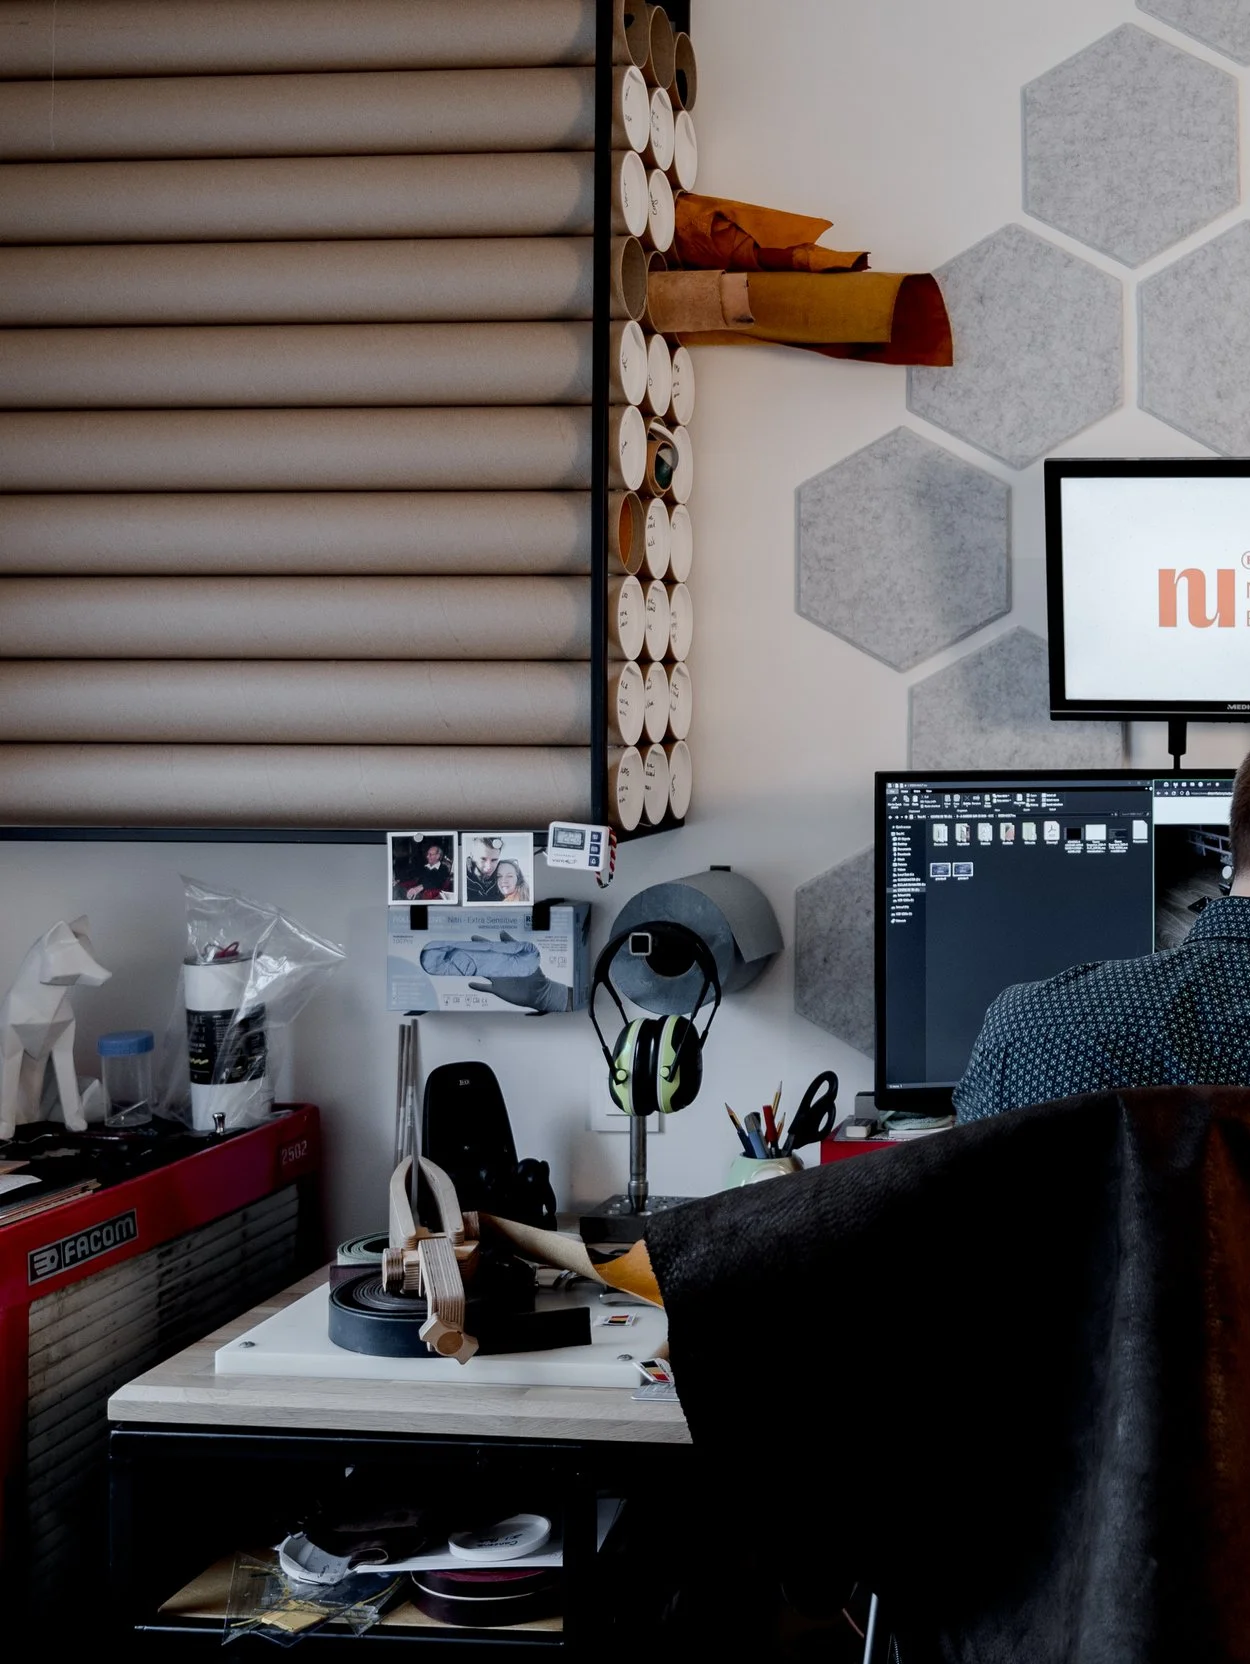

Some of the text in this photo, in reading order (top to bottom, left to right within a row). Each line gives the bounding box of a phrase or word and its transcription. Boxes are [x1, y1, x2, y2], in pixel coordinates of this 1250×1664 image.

[1158, 568, 1236, 628] nu
[281, 1140, 308, 1166] 2502
[64, 1215, 135, 1264] FACOM
